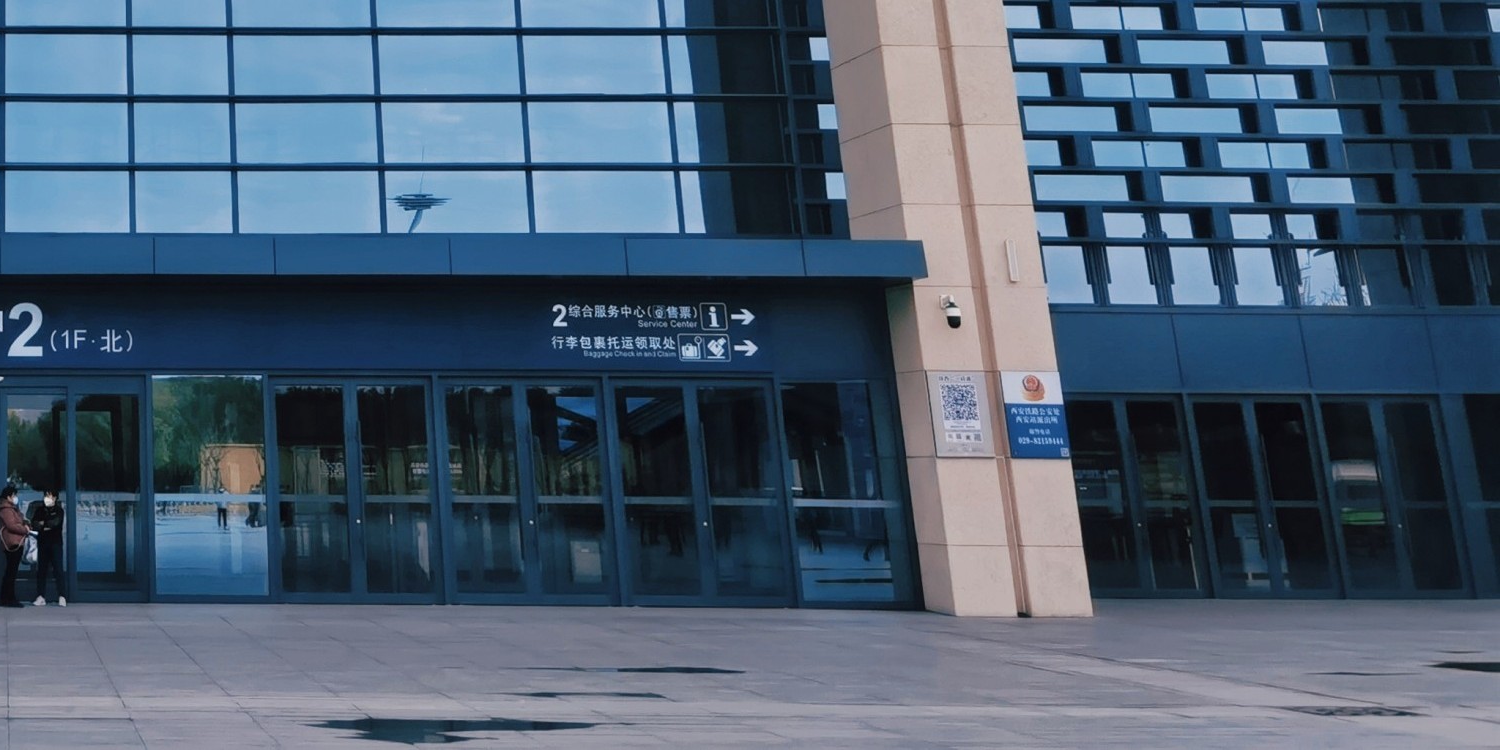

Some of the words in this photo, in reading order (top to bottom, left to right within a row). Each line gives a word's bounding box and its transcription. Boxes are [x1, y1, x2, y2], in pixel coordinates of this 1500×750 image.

[552, 304, 568, 327] 2
[637, 320, 668, 328] Service
[670, 320, 698, 328] Center
[7, 302, 43, 357] 2
[551, 336, 676, 350] 行李包裹托运领取处
